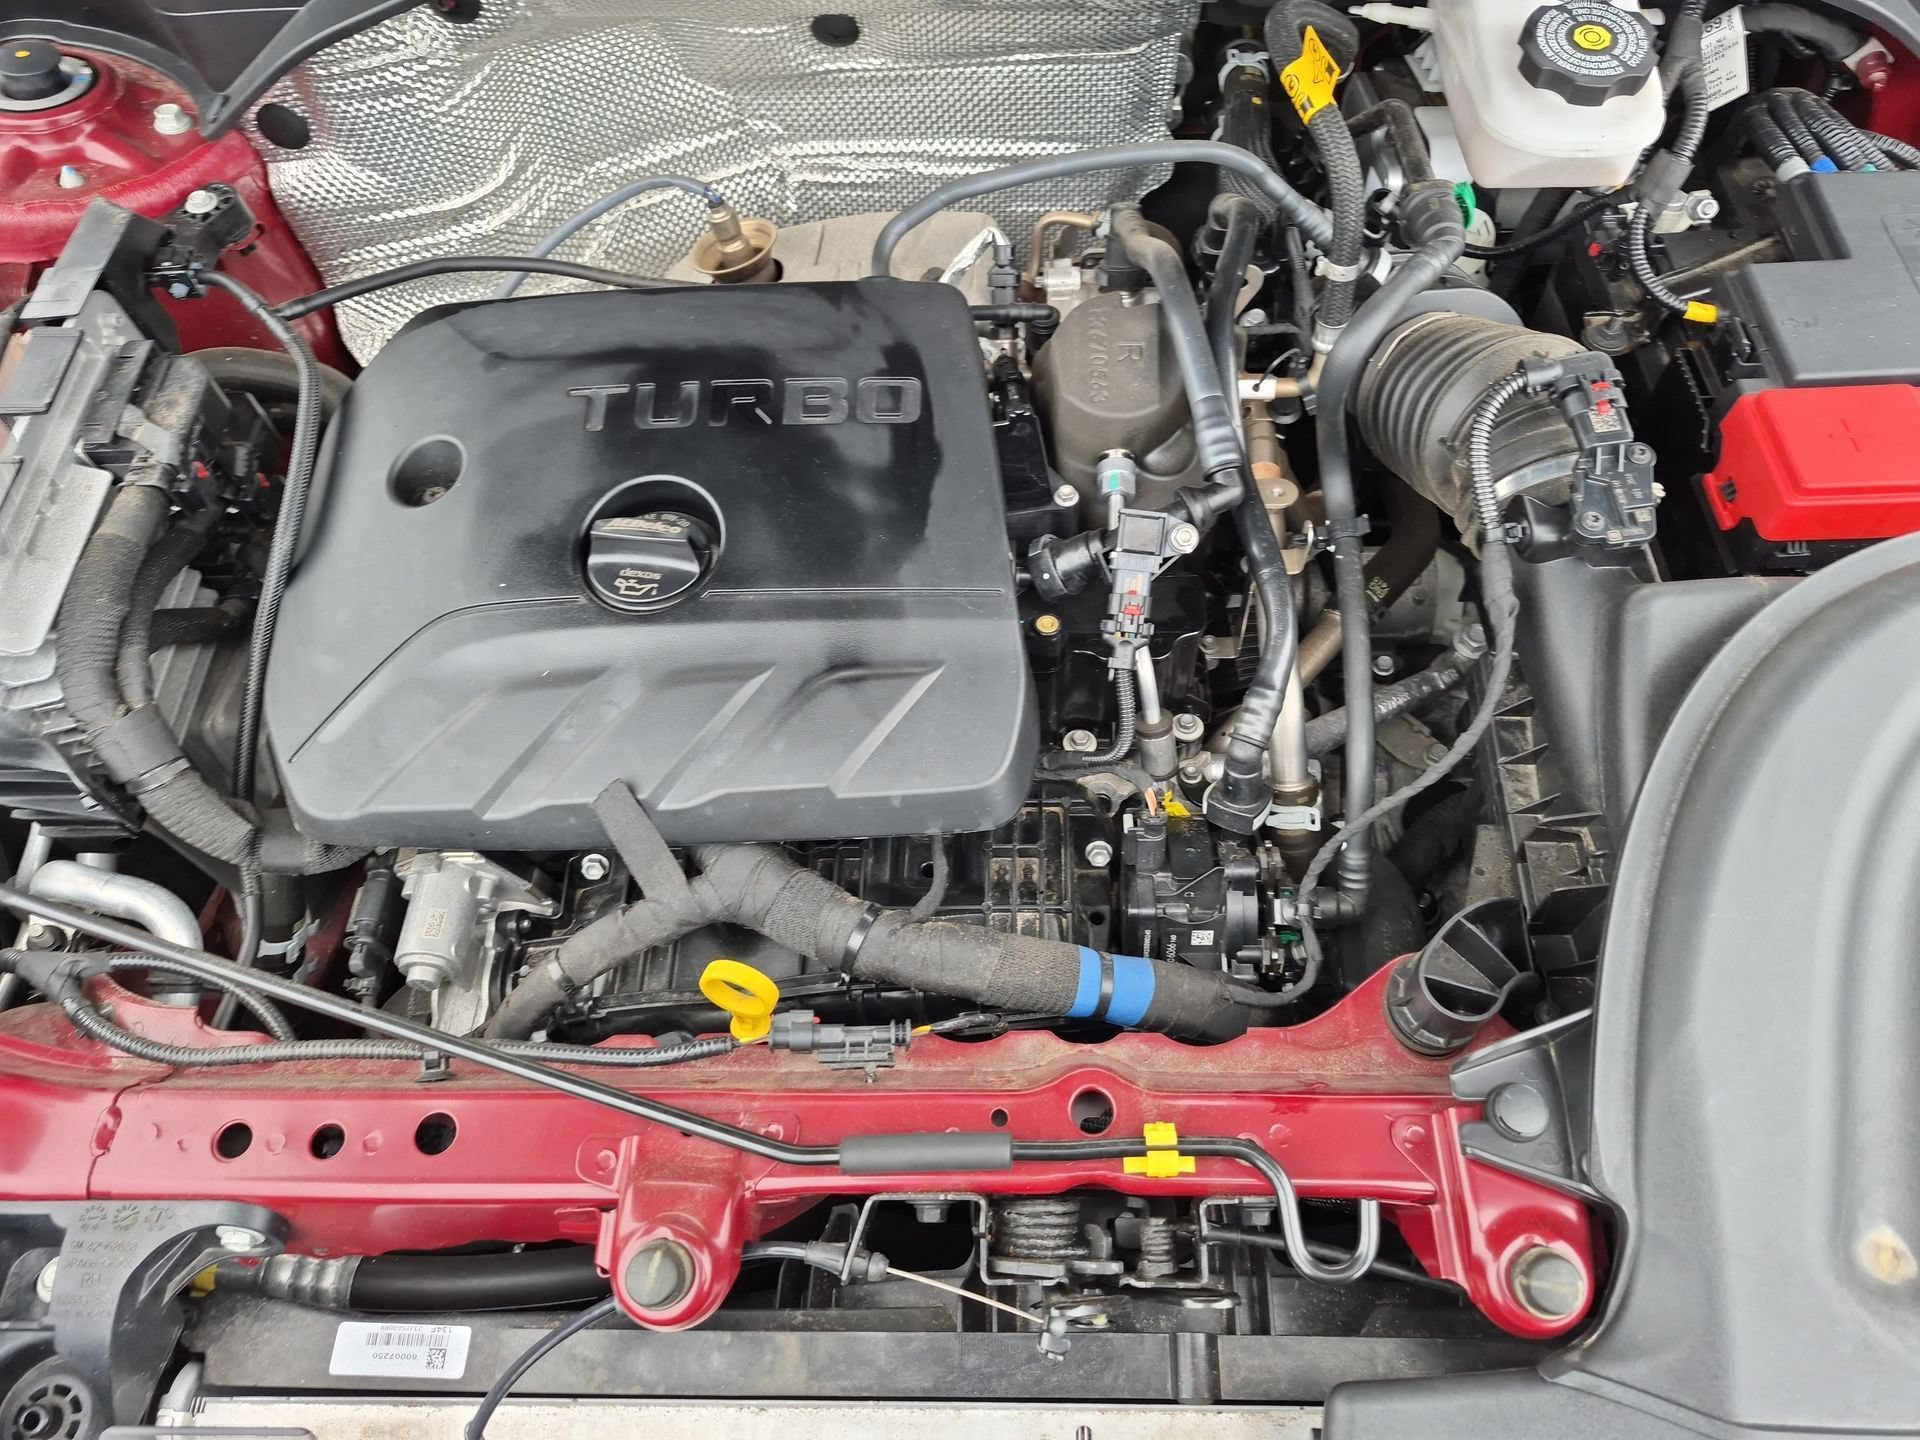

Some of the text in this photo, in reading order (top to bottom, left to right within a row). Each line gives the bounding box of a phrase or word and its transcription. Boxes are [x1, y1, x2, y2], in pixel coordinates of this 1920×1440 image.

[567, 376, 922, 432] TURBO
[619, 567, 662, 580] dexos
[80, 1272, 102, 1288] RH
[372, 1352, 418, 1360] 60007250
